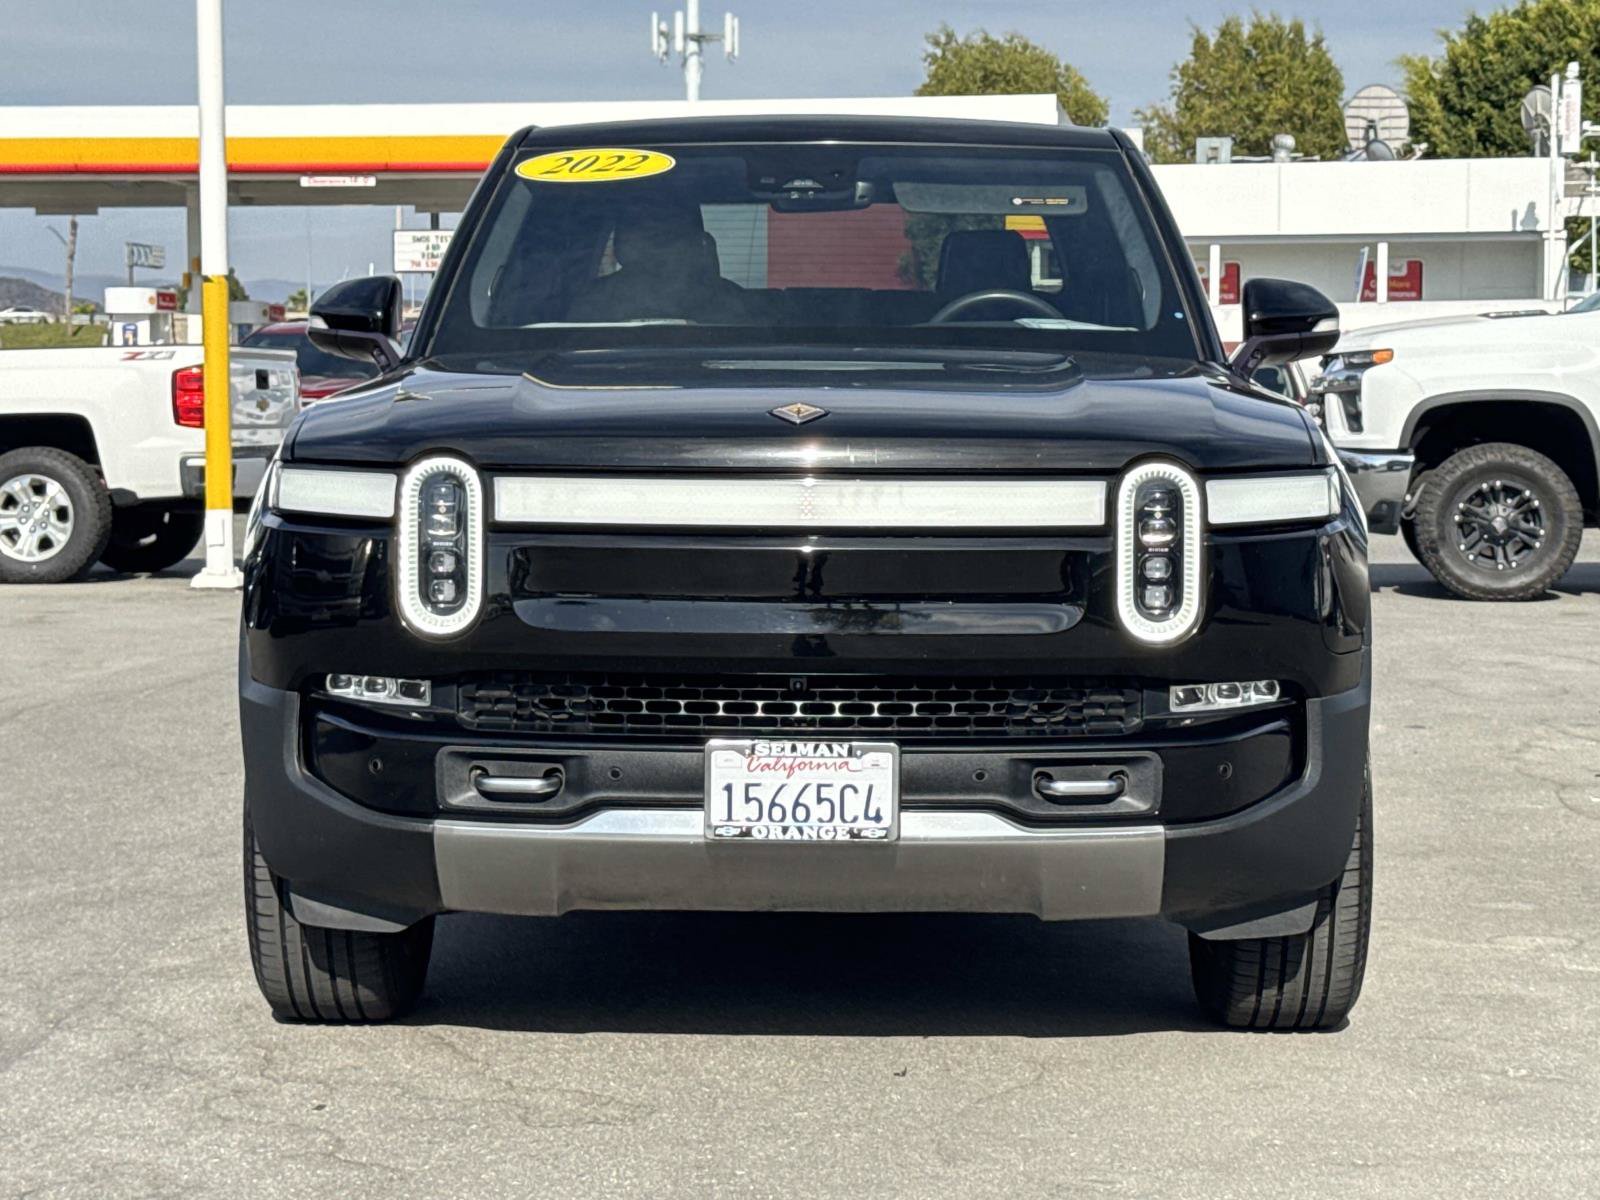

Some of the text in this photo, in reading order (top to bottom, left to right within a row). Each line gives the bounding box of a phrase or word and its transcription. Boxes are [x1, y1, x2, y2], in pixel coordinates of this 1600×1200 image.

[538, 154, 651, 175] 2022
[754, 743, 850, 758] SELMAN
[747, 755, 862, 779] California
[719, 783, 884, 824] 15665C4
[751, 825, 850, 841] ORANGE
